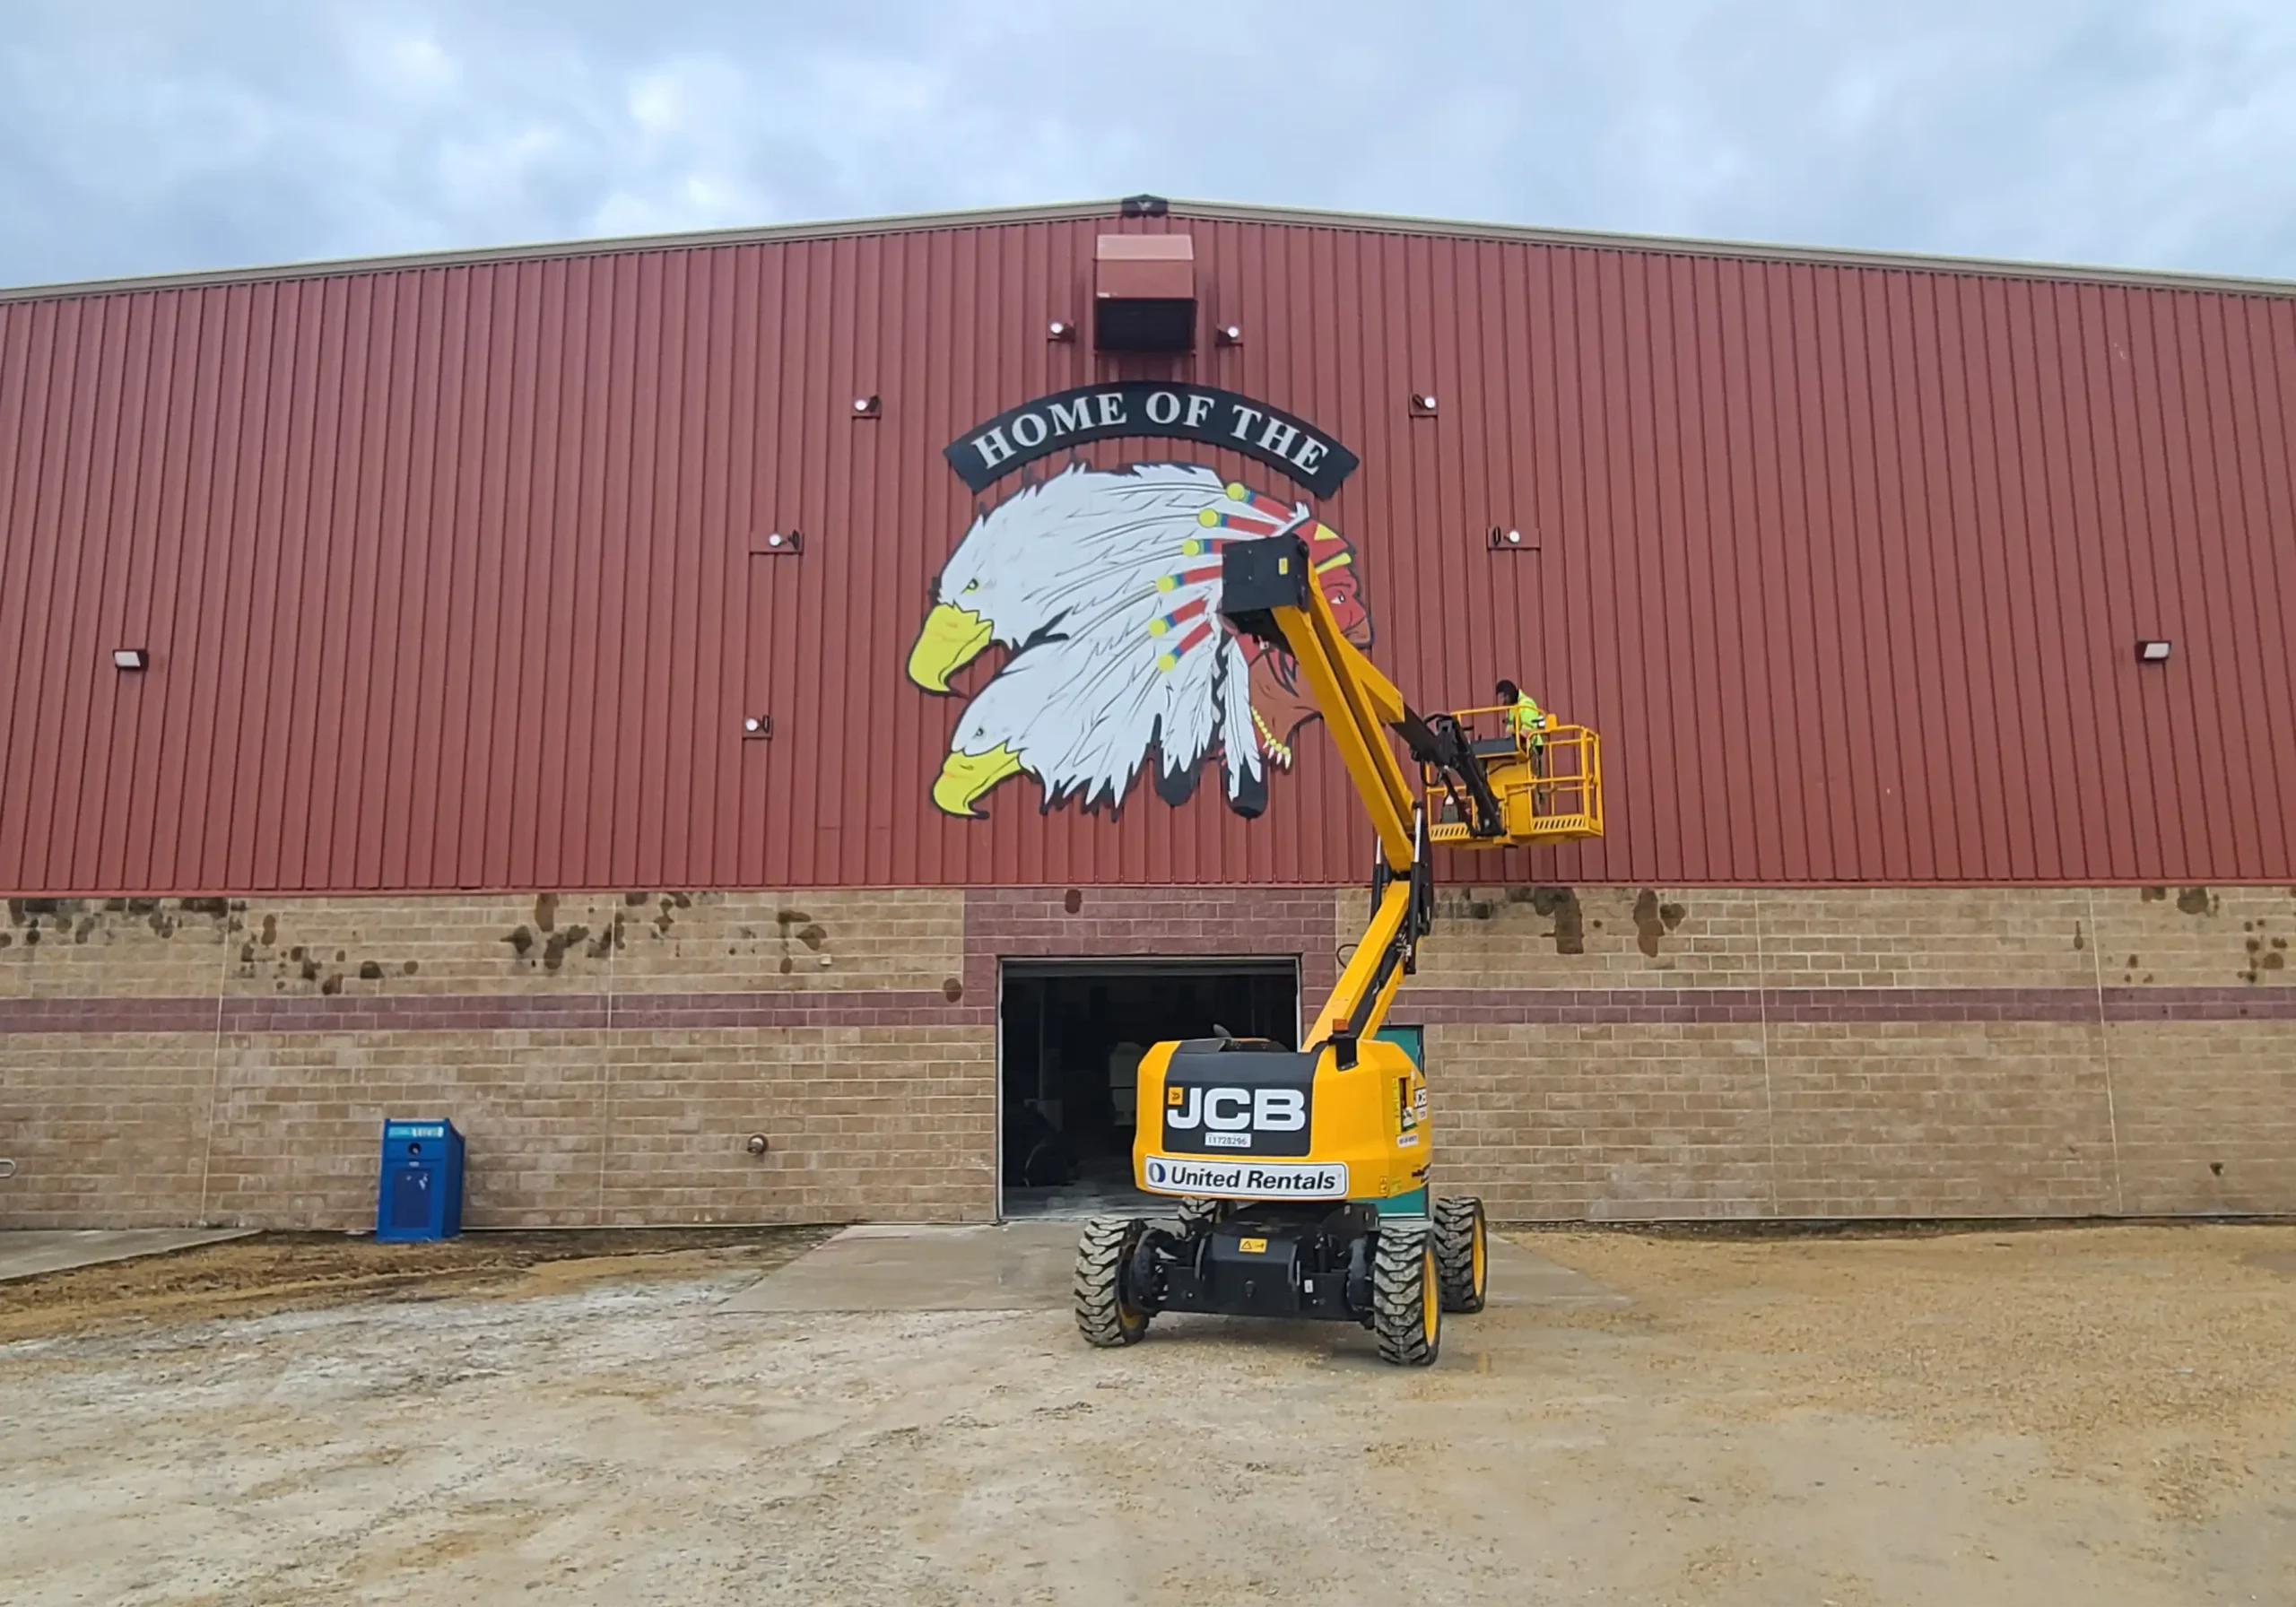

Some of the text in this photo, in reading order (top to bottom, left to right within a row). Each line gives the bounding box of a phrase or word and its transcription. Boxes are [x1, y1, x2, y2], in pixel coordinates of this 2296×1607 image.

[971, 392, 1328, 474] HOME OF THE
[1168, 1088, 1305, 1130] JCB
[1170, 1166, 1335, 1190] United Rentals
